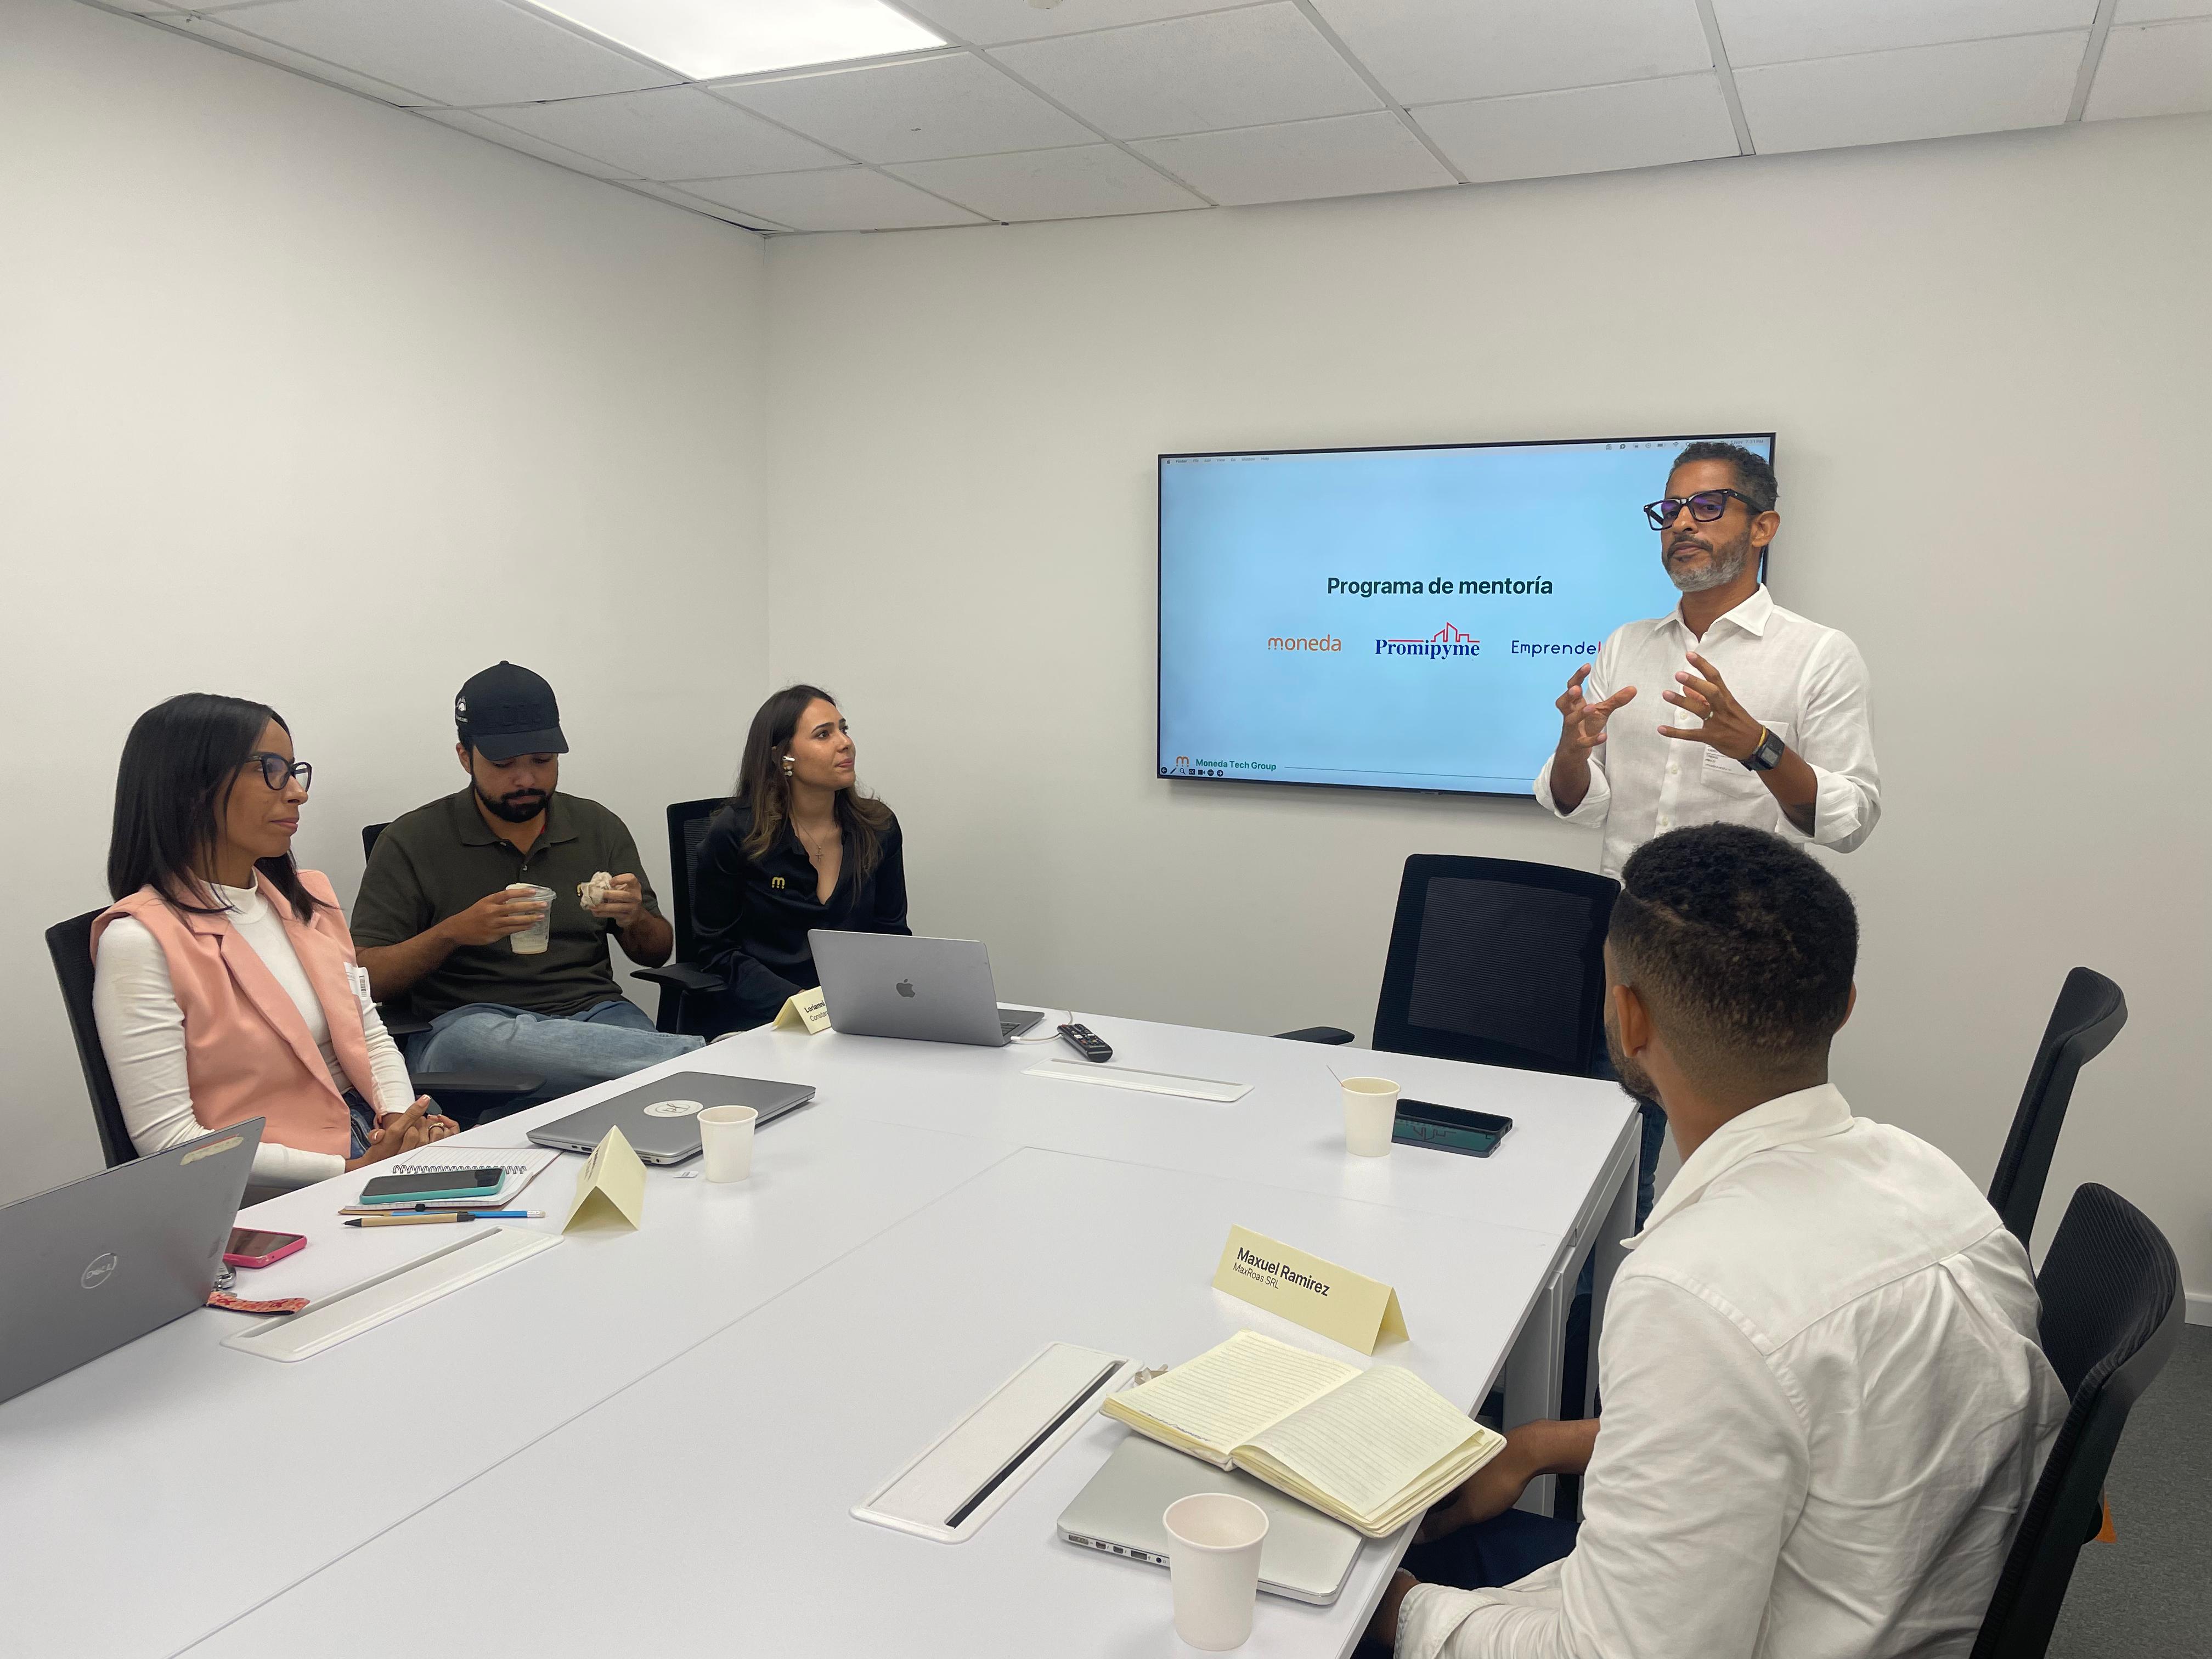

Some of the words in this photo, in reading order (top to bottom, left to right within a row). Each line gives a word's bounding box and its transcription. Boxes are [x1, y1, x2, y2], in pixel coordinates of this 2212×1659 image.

[1327, 577, 1423, 597] Programa
[1428, 577, 1453, 594] de
[1459, 575, 1553, 594] mentoría
[1268, 634, 1342, 651] moneda
[1375, 639, 1480, 659] Promipyme
[1196, 759, 1227, 768] Moneda
[1229, 760, 1249, 769] Tech
[1251, 761, 1277, 771] Group
[1233, 1262, 1264, 1283] MaxRoas
[1265, 1276, 1279, 1289] SRL
[1237, 1247, 1280, 1276] Maxuel
[1280, 1265, 1330, 1297] Ramirez
